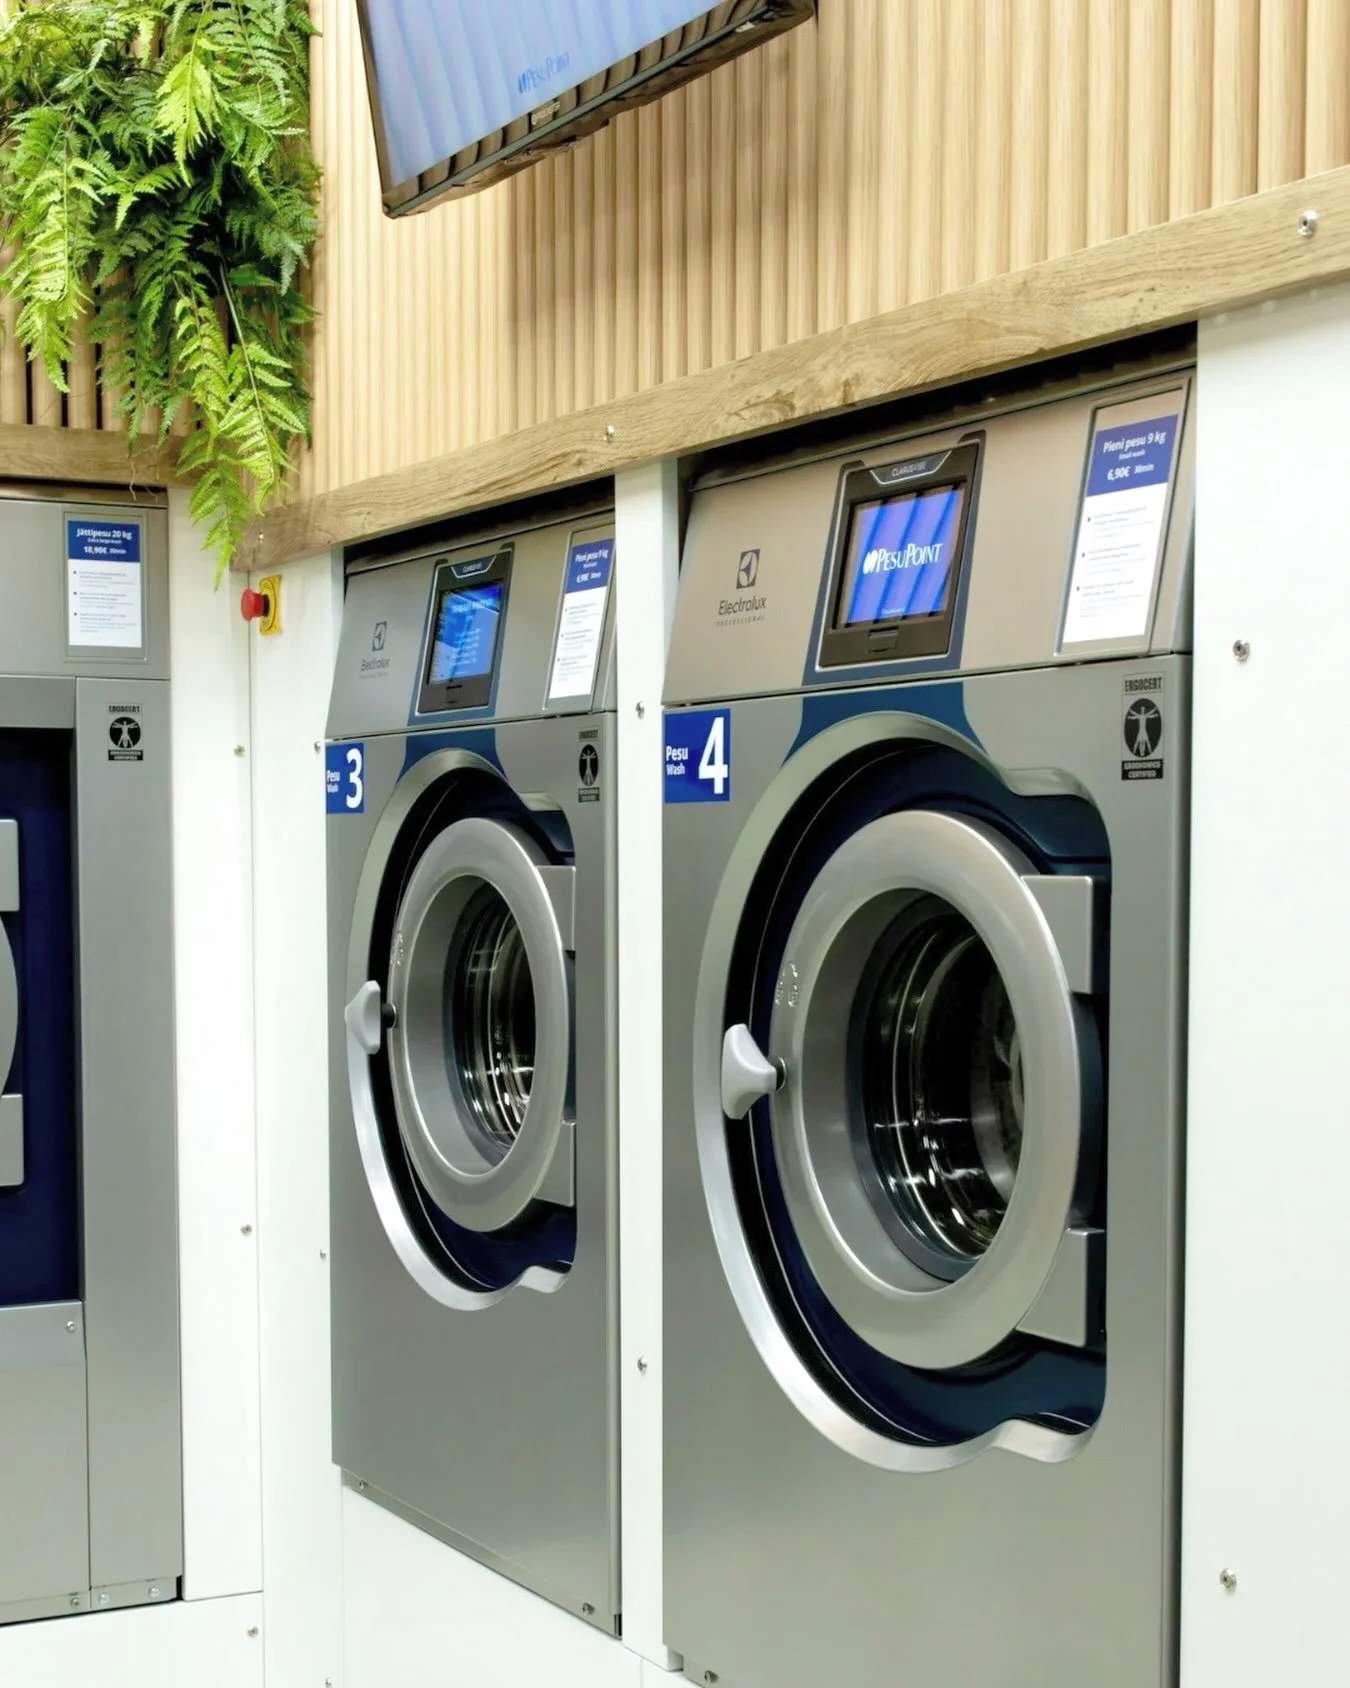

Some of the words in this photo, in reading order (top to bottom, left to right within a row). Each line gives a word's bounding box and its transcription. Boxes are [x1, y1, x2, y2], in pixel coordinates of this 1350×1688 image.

[1124, 436, 1146, 451] pesu
[1147, 432, 1155, 444] 9
[1154, 431, 1167, 445] kg
[1107, 465, 1131, 481] 6,90€
[76, 528, 112, 540] Jättipesu
[112, 530, 122, 538] 20
[122, 530, 133, 541] kg
[718, 595, 768, 615] Electrolux
[1124, 677, 1163, 692] ERGOCERT
[665, 745, 689, 761] Pesu
[698, 717, 729, 794] 4
[665, 763, 686, 776] Wash
[346, 748, 363, 809] 3
